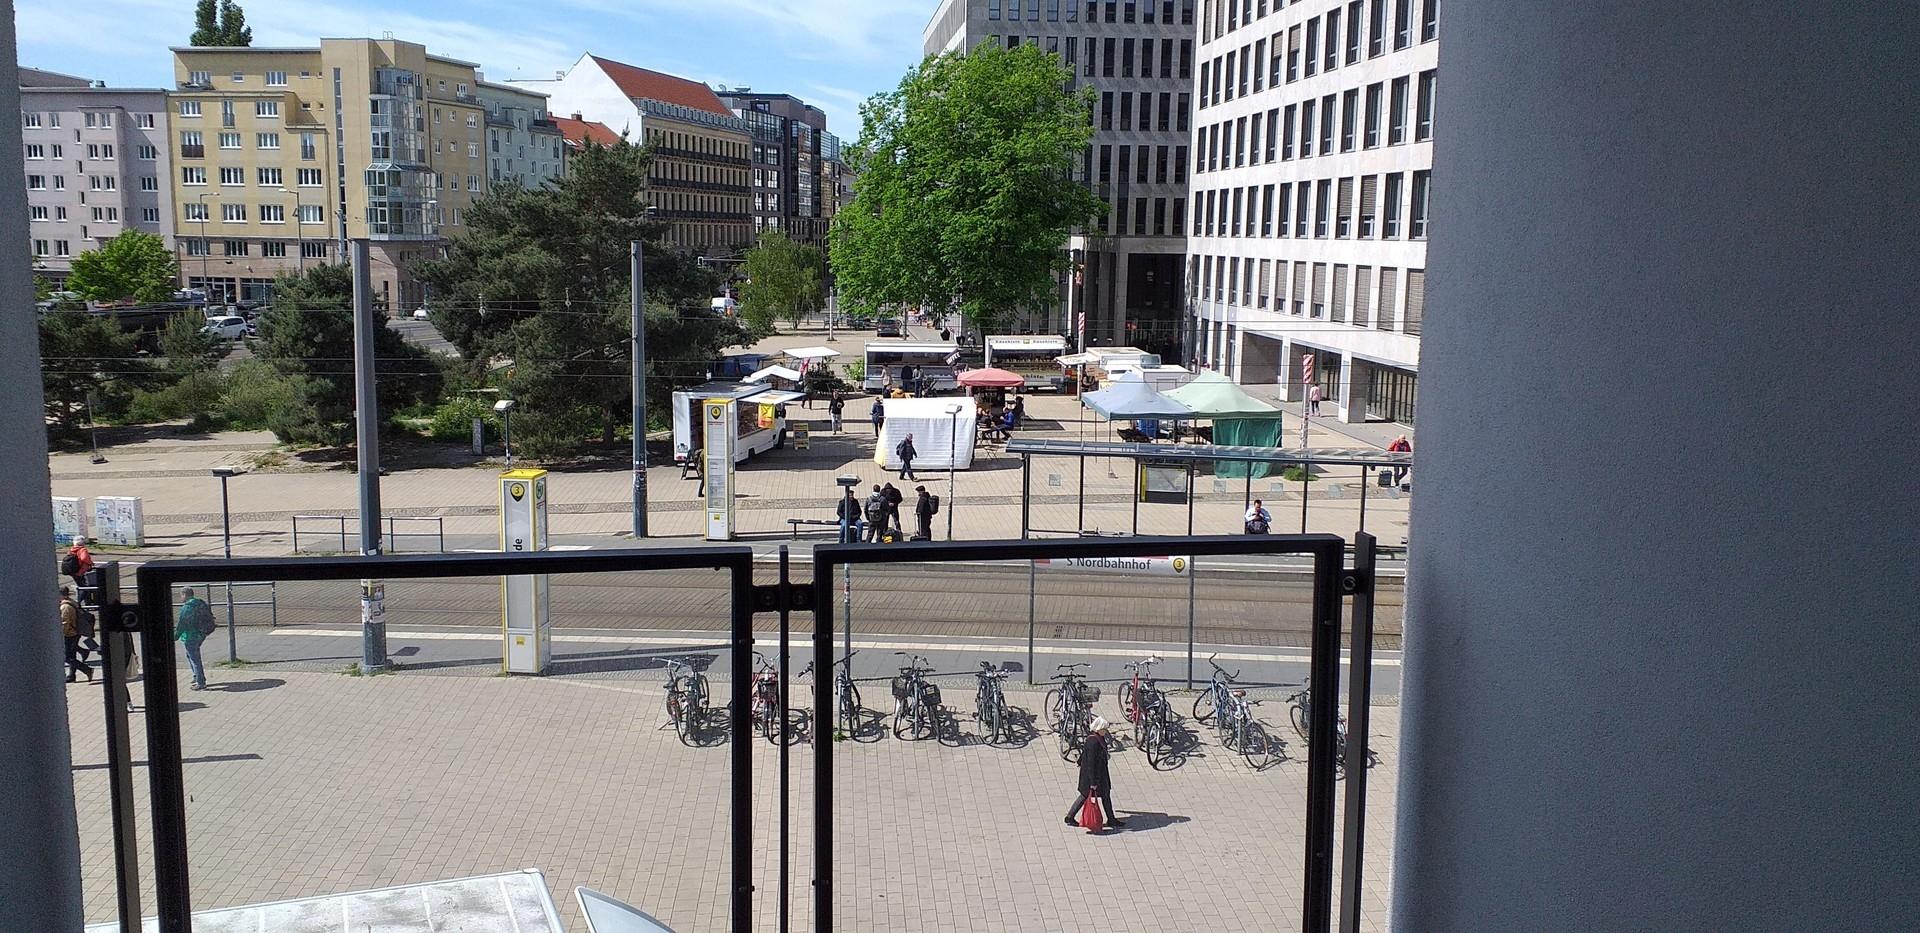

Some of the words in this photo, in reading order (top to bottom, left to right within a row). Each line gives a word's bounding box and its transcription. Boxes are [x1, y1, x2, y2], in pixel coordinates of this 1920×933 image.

[514, 486, 520, 494] 3
[1066, 557, 1073, 566] S
[1077, 557, 1152, 570] Nordbahnhof
[1176, 560, 1182, 568] 3
